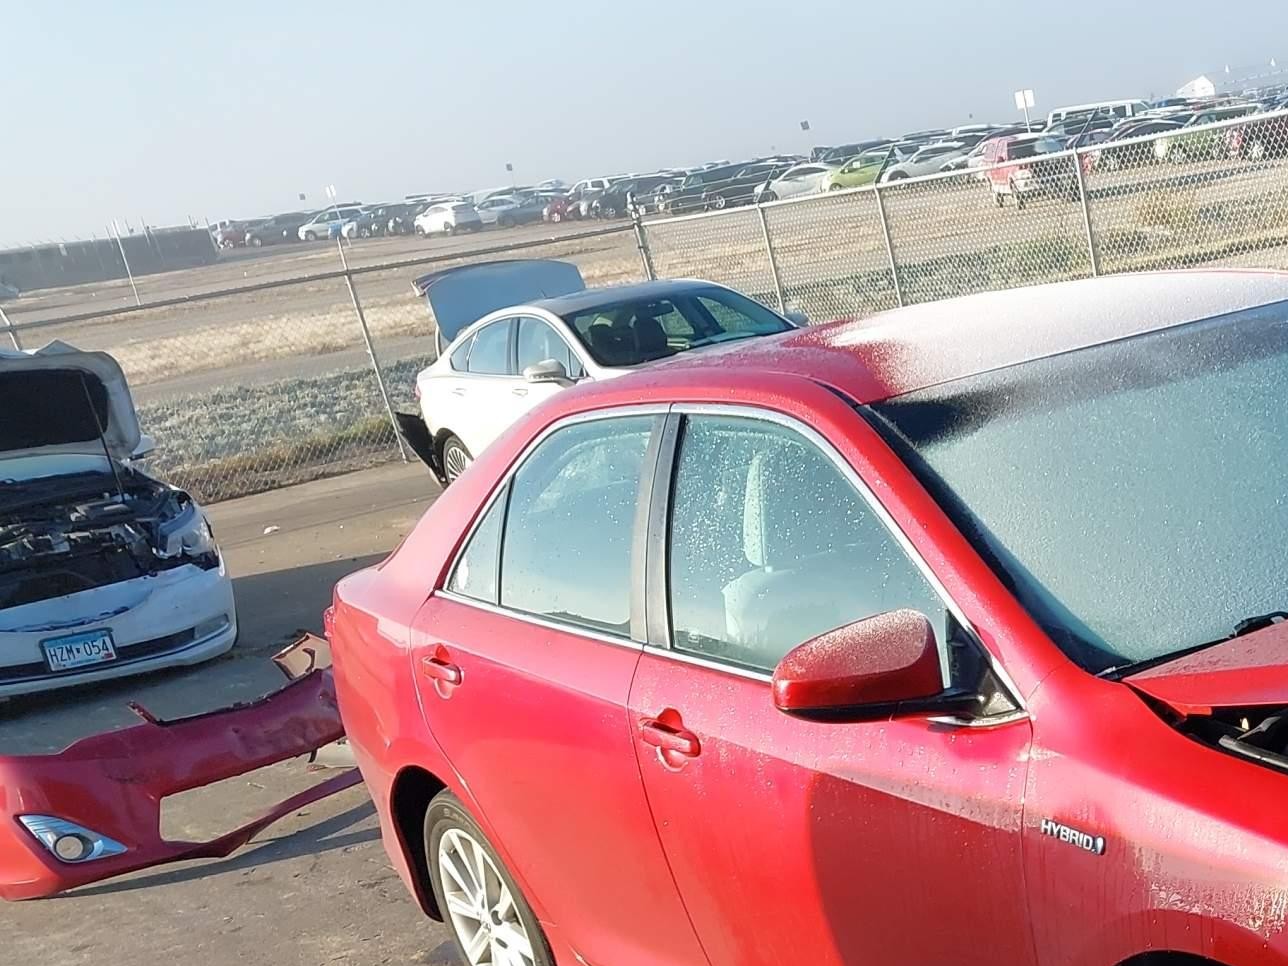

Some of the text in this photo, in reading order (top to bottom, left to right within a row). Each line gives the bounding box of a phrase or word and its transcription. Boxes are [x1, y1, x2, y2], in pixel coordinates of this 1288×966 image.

[48, 645, 76, 664] HZM
[83, 638, 110, 656] 054
[1041, 818, 1094, 851] HYBRID
